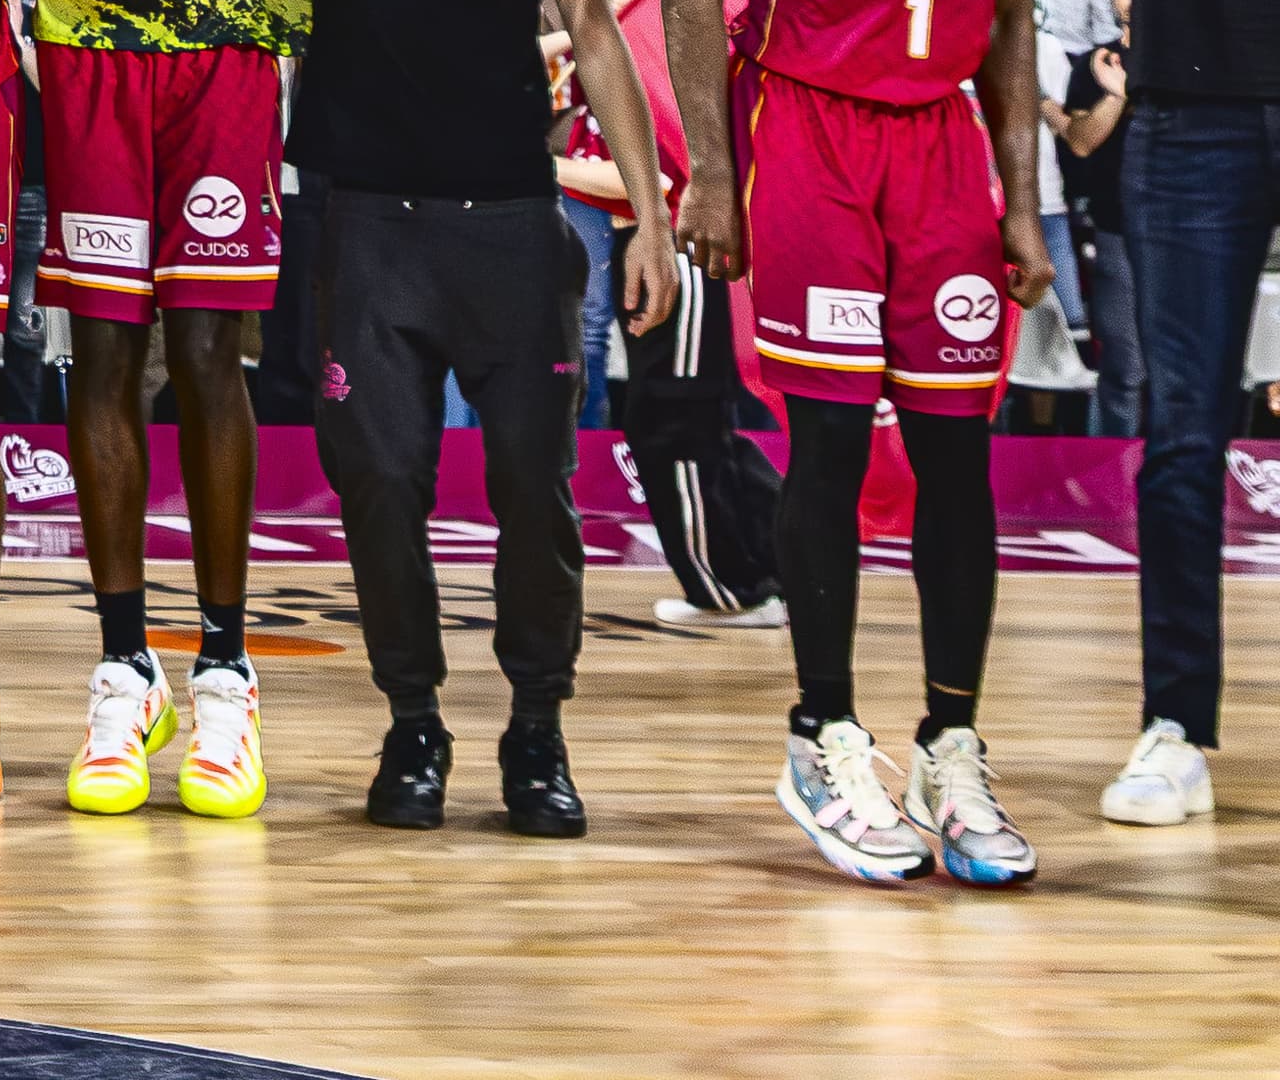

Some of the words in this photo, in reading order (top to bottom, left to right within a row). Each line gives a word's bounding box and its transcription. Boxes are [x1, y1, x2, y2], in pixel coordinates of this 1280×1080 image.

[187, 194, 241, 220] Q2
[75, 226, 133, 253] PONS
[941, 294, 999, 322] Q2
